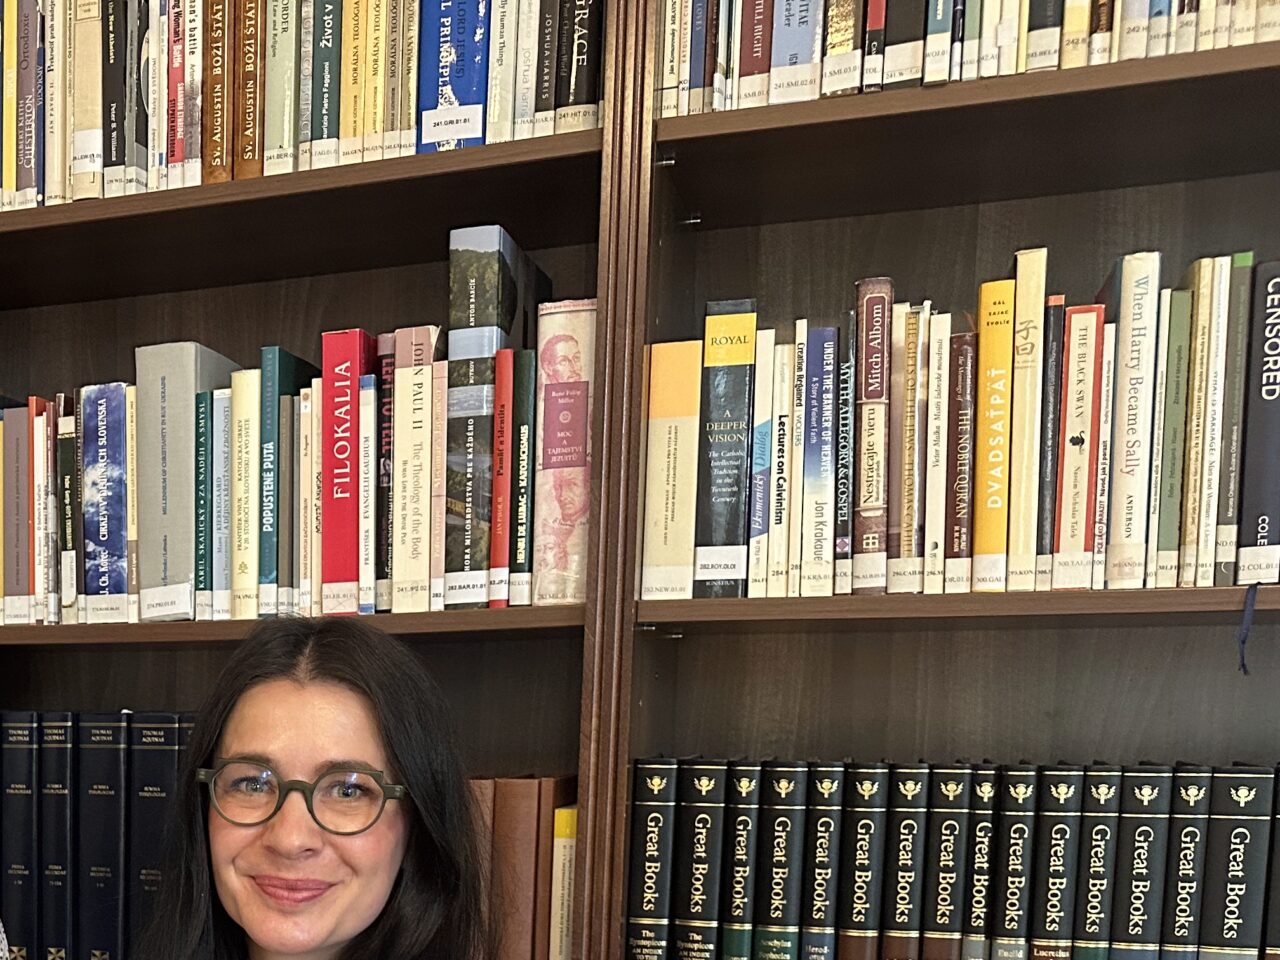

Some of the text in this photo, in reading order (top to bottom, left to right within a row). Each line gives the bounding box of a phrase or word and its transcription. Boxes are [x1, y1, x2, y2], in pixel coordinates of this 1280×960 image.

[20, 13, 30, 70] Ortodoxie
[211, 4, 223, 37] ŠTÁT
[212, 42, 222, 75] BOŽÍ
[244, 2, 255, 35] ŠTÁT
[245, 39, 254, 71] BOŽÍ
[542, 60, 550, 99] HARRIS
[412, 342, 424, 429] JOHN PAUL II
[710, 335, 749, 345] ROYAL
[868, 305, 882, 391] Mitch Albom
[1120, 275, 1149, 476] When Harry Became Sally
[1261, 277, 1280, 400] CENSORED
[334, 361, 350, 499] FILOKALIA
[752, 430, 768, 529] Ekumenický Dialóg
[774, 415, 788, 525] Lectures on Calvinism
[863, 407, 876, 504] Nestrácajte vieru
[987, 367, 1006, 508] DVADSAŤPÄŤ
[261, 442, 273, 531] POPUSTENÉ PUTÁ
[1125, 494, 1133, 538] ANDERSON
[643, 812, 662, 910] Great Books
[690, 814, 710, 912] Great Books
[732, 815, 751, 916] Great Books
[770, 817, 791, 918] Great Books
[813, 817, 833, 919] Great Books
[852, 819, 874, 921] Great Books
[896, 819, 917, 922] Great Books
[939, 820, 959, 924] Great Books
[971, 822, 992, 927] Great Books
[1005, 823, 1028, 929] Great Books
[1045, 823, 1068, 931] Great Books
[1085, 824, 1109, 933] Great Books
[1129, 826, 1153, 935] Great Books
[1174, 826, 1199, 936] Great Books
[1224, 827, 1249, 938] Great Books
